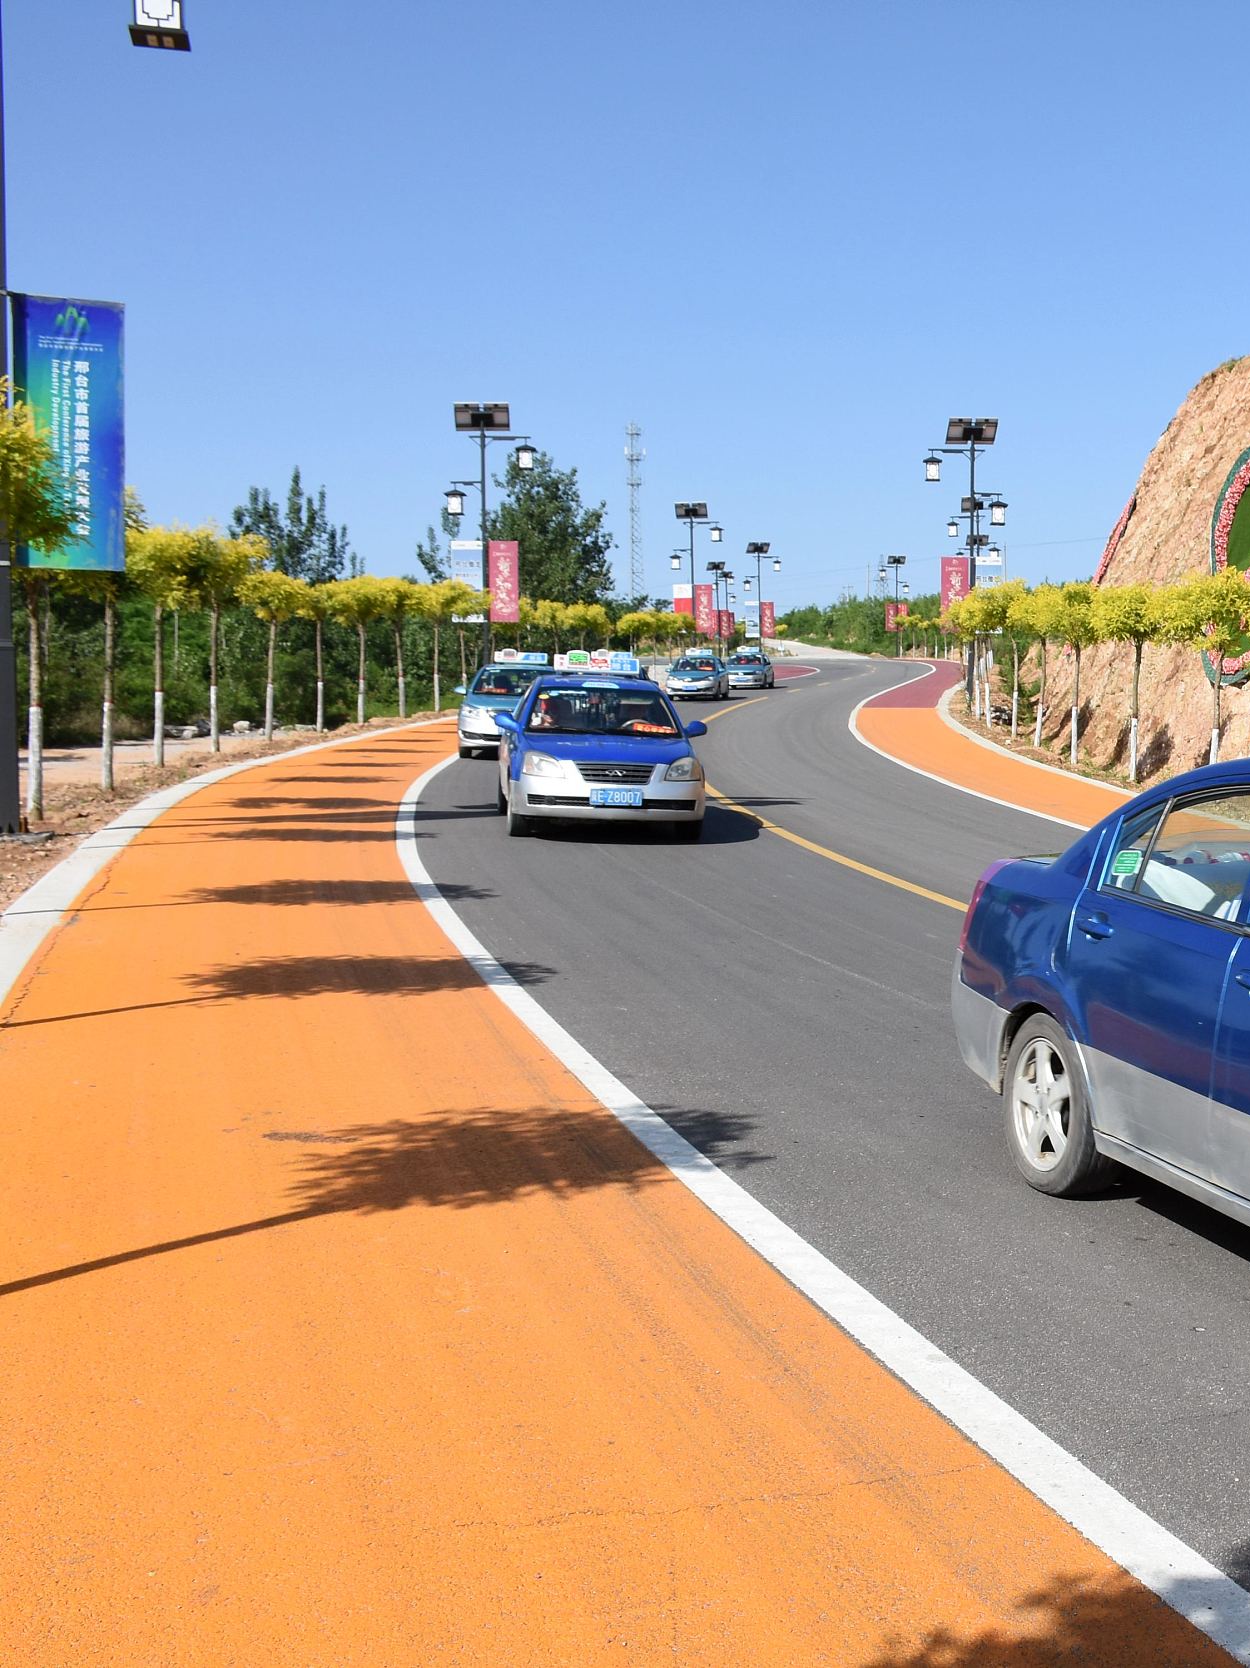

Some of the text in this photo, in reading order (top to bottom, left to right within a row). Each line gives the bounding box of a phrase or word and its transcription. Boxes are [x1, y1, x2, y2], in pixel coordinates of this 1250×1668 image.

[62, 360, 71, 375] The
[62, 378, 71, 398] First
[50, 359, 60, 452] Industry Development
[62, 400, 71, 447] Conference
